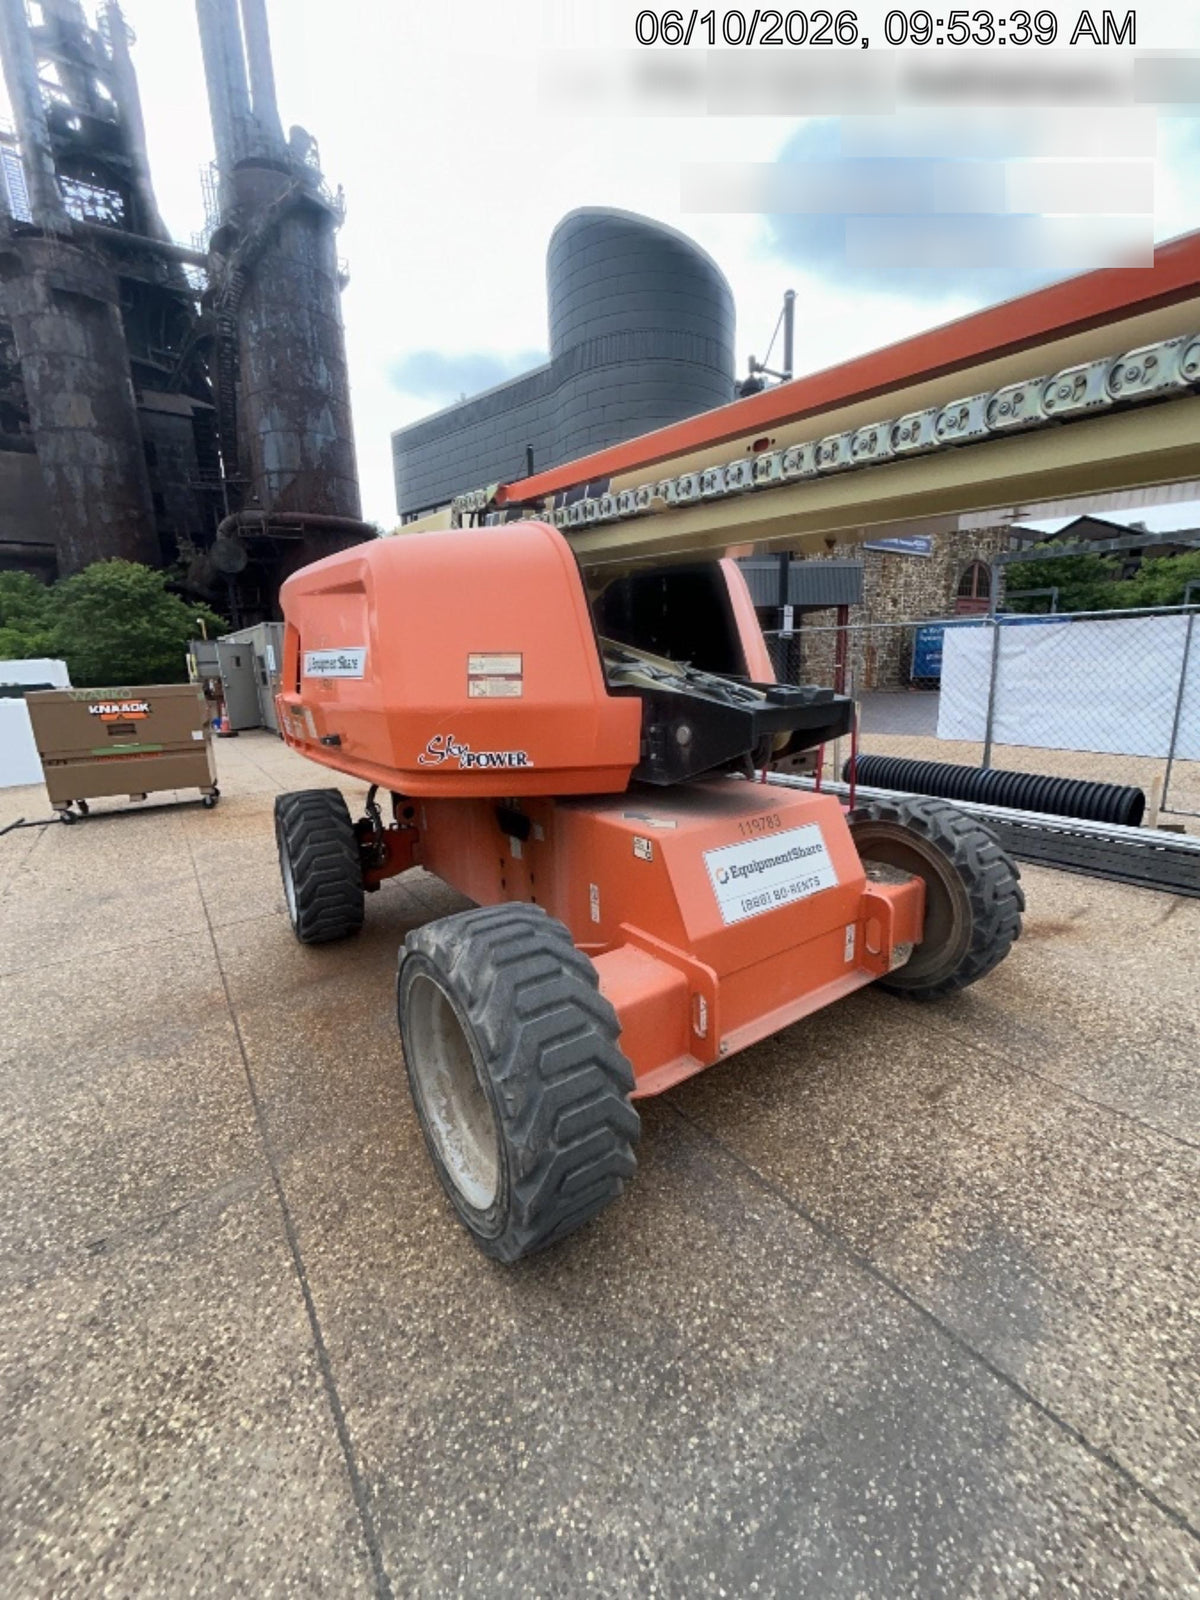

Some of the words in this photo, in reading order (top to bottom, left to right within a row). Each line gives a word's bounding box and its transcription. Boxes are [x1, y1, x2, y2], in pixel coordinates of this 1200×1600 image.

[88, 702, 151, 716] KNAACK
[737, 814, 782, 836] 119783
[729, 843, 823, 879] EquipmentShare
